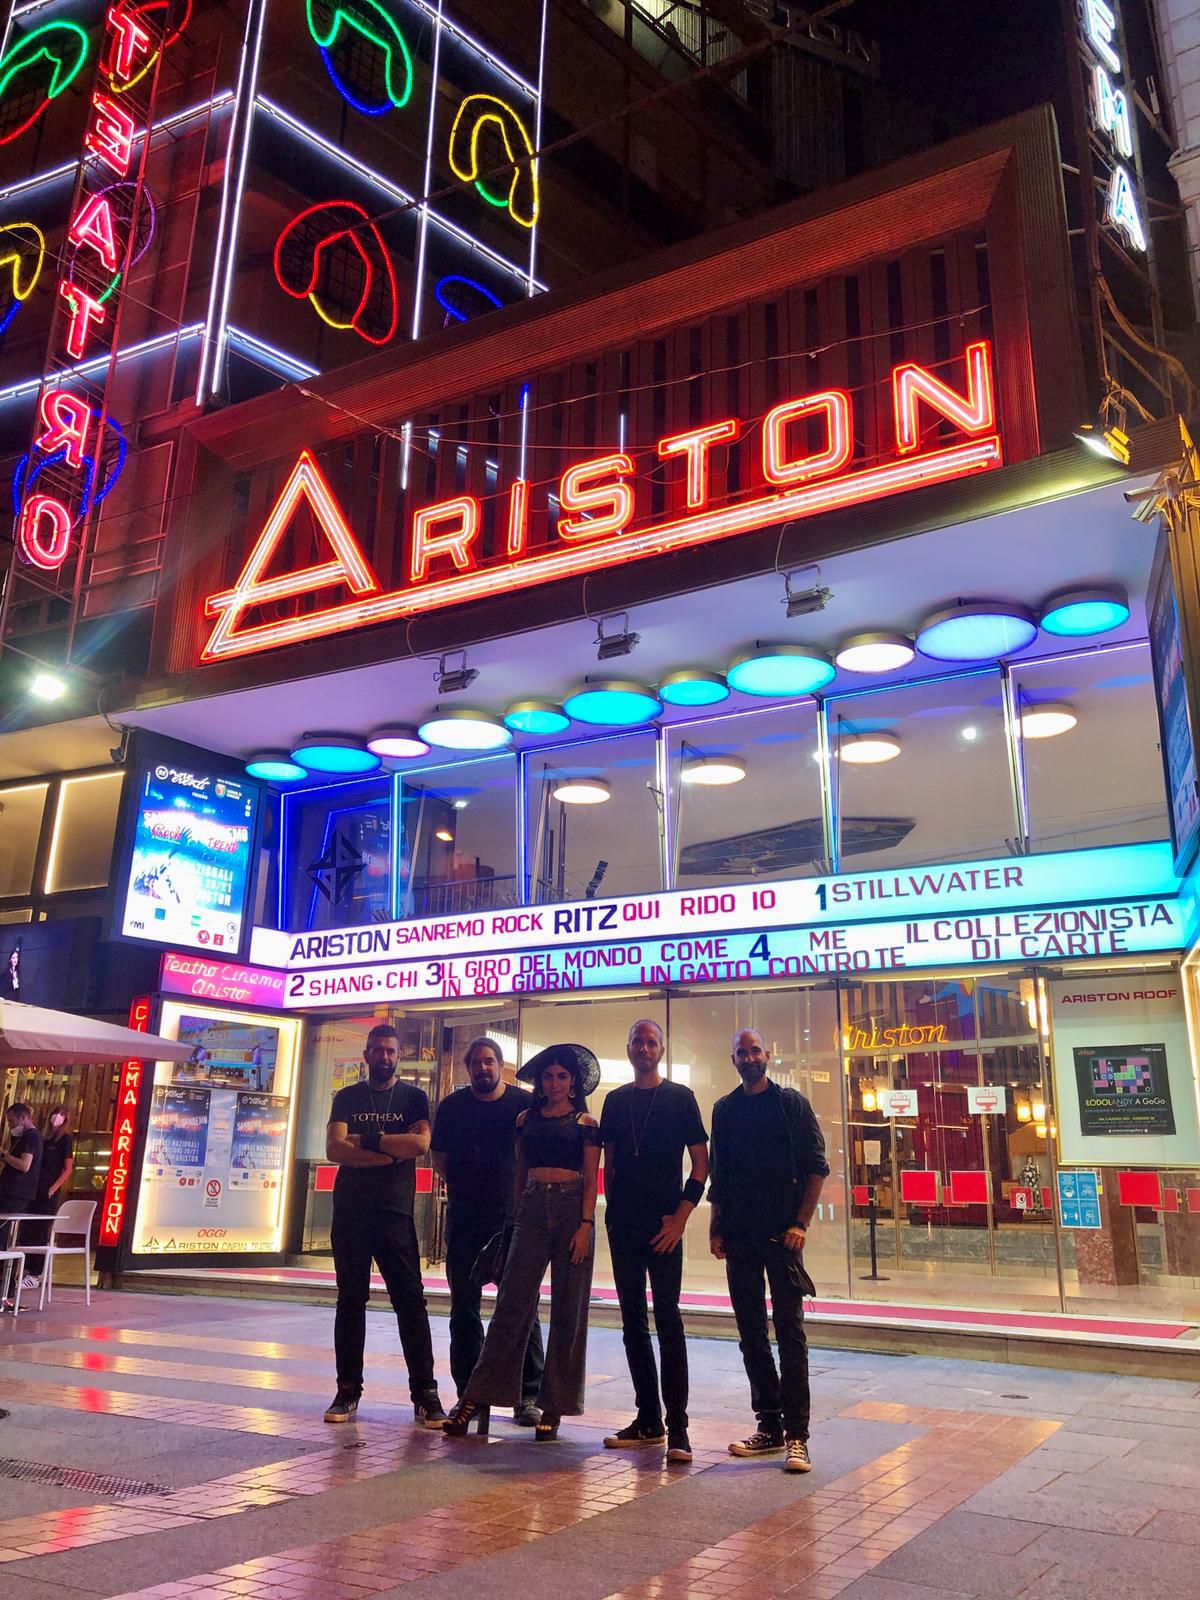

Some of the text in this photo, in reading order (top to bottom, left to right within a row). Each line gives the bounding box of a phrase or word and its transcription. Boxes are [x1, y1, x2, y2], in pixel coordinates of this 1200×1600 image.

[202, 340, 1000, 661] ARISTON
[290, 866, 1023, 960] ARISTON SANREMO ROCK RITZ QUI RIDO IO 1 STILLWATER
[165, 955, 219, 977] Teatro
[290, 975, 305, 997] 2
[425, 962, 442, 986] 3
[441, 962, 459, 979] IL
[465, 958, 511, 979] GIRO
[520, 954, 560, 974] DEL
[565, 946, 642, 970] MONDO
[661, 938, 728, 962] COME
[749, 934, 771, 961] 4
[810, 930, 847, 951] ME
[906, 922, 928, 944] IL
[934, 903, 1173, 941] COLLEZIONISTA
[442, 930, 1128, 998] IN 80 GIORNI UN GATTO CONTRO TE DI CARTE
[1061, 989, 1177, 1004] ARISTON ROOF
[124, 1005, 147, 1105] CIEMA
[351, 1112, 404, 1123] TOTHEM
[105, 1118, 132, 1234] ARISTON
[163, 1238, 219, 1251] ARISTON
[197, 1229, 227, 1238] OGGI
